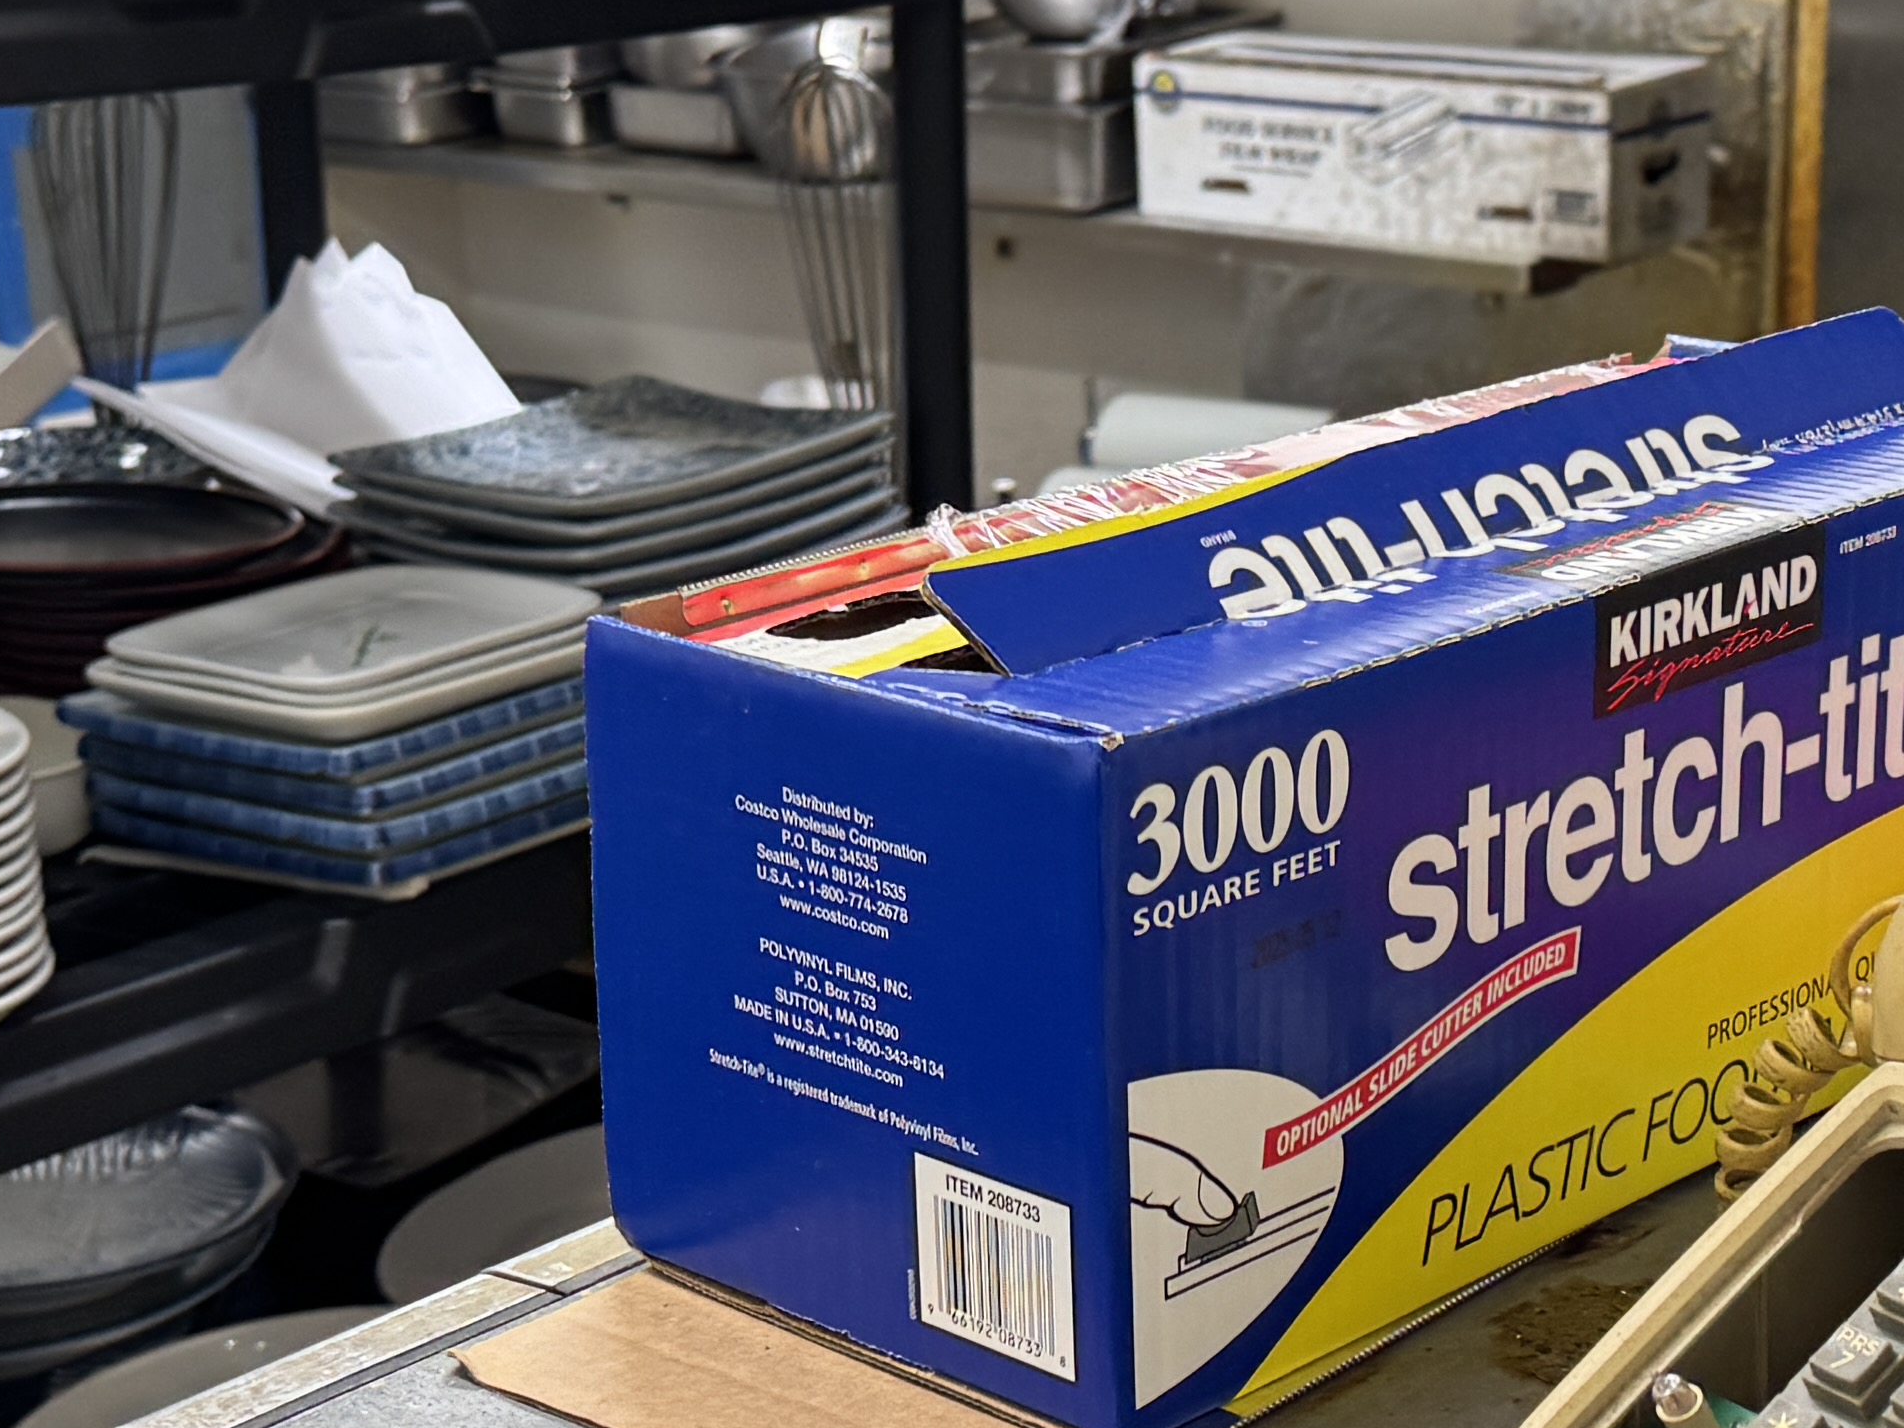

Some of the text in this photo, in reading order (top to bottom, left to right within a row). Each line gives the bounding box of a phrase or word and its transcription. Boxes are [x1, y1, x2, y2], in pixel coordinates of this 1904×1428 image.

[1541, 506, 1779, 581] KIRKLAND
[1608, 554, 1819, 669] KIRKLAND
[1607, 621, 1815, 712] Signature
[734, 793, 928, 865] Costco Wholesale Corporation
[781, 785, 874, 828] Distributed by:
[1126, 729, 1351, 896] 3000
[756, 842, 907, 902] Seattle, WA 98124-1535
[756, 863, 795, 890] U.S.A.
[781, 828, 879, 872] P.O. Box 34535
[1133, 840, 1342, 936] SQUARE FEET
[779, 894, 889, 940] www.costco.com
[759, 937, 913, 1002] POLYVINYL FILMS, INC.
[794, 970, 822, 995] P.O.
[853, 990, 877, 1012] 753
[734, 994, 831, 1042] MADE IN U.S.A.
[774, 986, 857, 1029] SUTTON, MA
[1707, 974, 1833, 1049] PROFESSIONA
[774, 1032, 904, 1088] www.stretchtite.com
[1276, 940, 1566, 1157] OPTIONAL SLIDE CUTTER INCLUDED
[784, 1073, 830, 1104] registered
[830, 1090, 878, 1122] trademark
[1423, 1059, 1772, 1266] PLASTIC FOO
[946, 1174, 1041, 1223] ITEM 208733
[1827, 1349, 1857, 1373] 7
[1837, 1326, 1880, 1358] PRS
